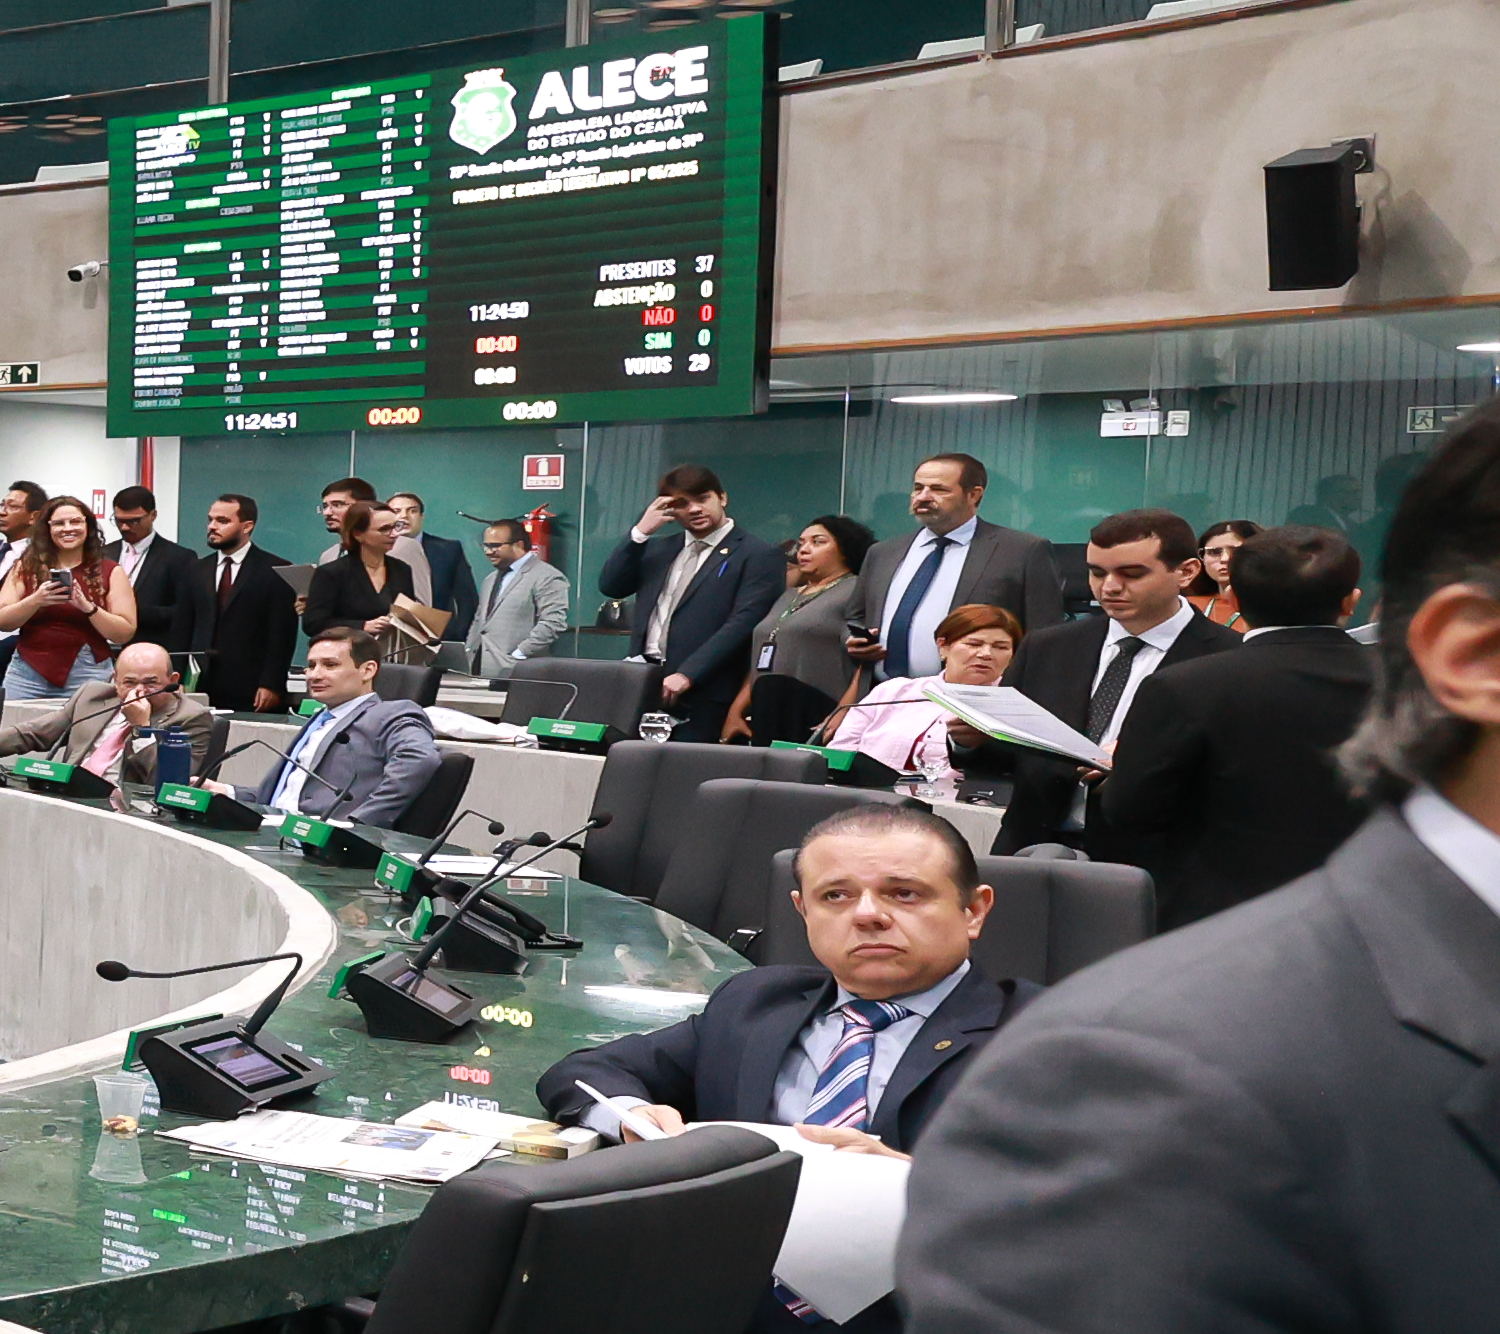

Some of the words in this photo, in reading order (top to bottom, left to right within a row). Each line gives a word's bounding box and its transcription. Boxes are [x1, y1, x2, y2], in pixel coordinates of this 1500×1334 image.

[528, 45, 709, 119] ALECE
[527, 115, 612, 139] ASSEMBLEIA
[614, 100, 708, 126] LEGISLATIVA
[527, 138, 549, 151] DO
[551, 128, 607, 147] ESTADO
[609, 125, 631, 140] DO
[634, 115, 685, 136] CEARÁ
[599, 259, 676, 282] PRESENTES
[695, 254, 714, 273] 37
[593, 281, 675, 307] ABSTENÇÃO
[700, 279, 713, 298] 0
[643, 306, 676, 326] NÃO
[700, 304, 713, 322] 0
[475, 335, 518, 354] 00:00
[644, 332, 672, 350] SIM
[698, 328, 710, 346] 0
[624, 356, 672, 375] VOTOS
[688, 353, 711, 372] 29
[224, 412, 297, 431] 11:24:51
[368, 407, 420, 425] 00:00
[503, 400, 557, 421] 00:00
[94, 494, 104, 515] H
